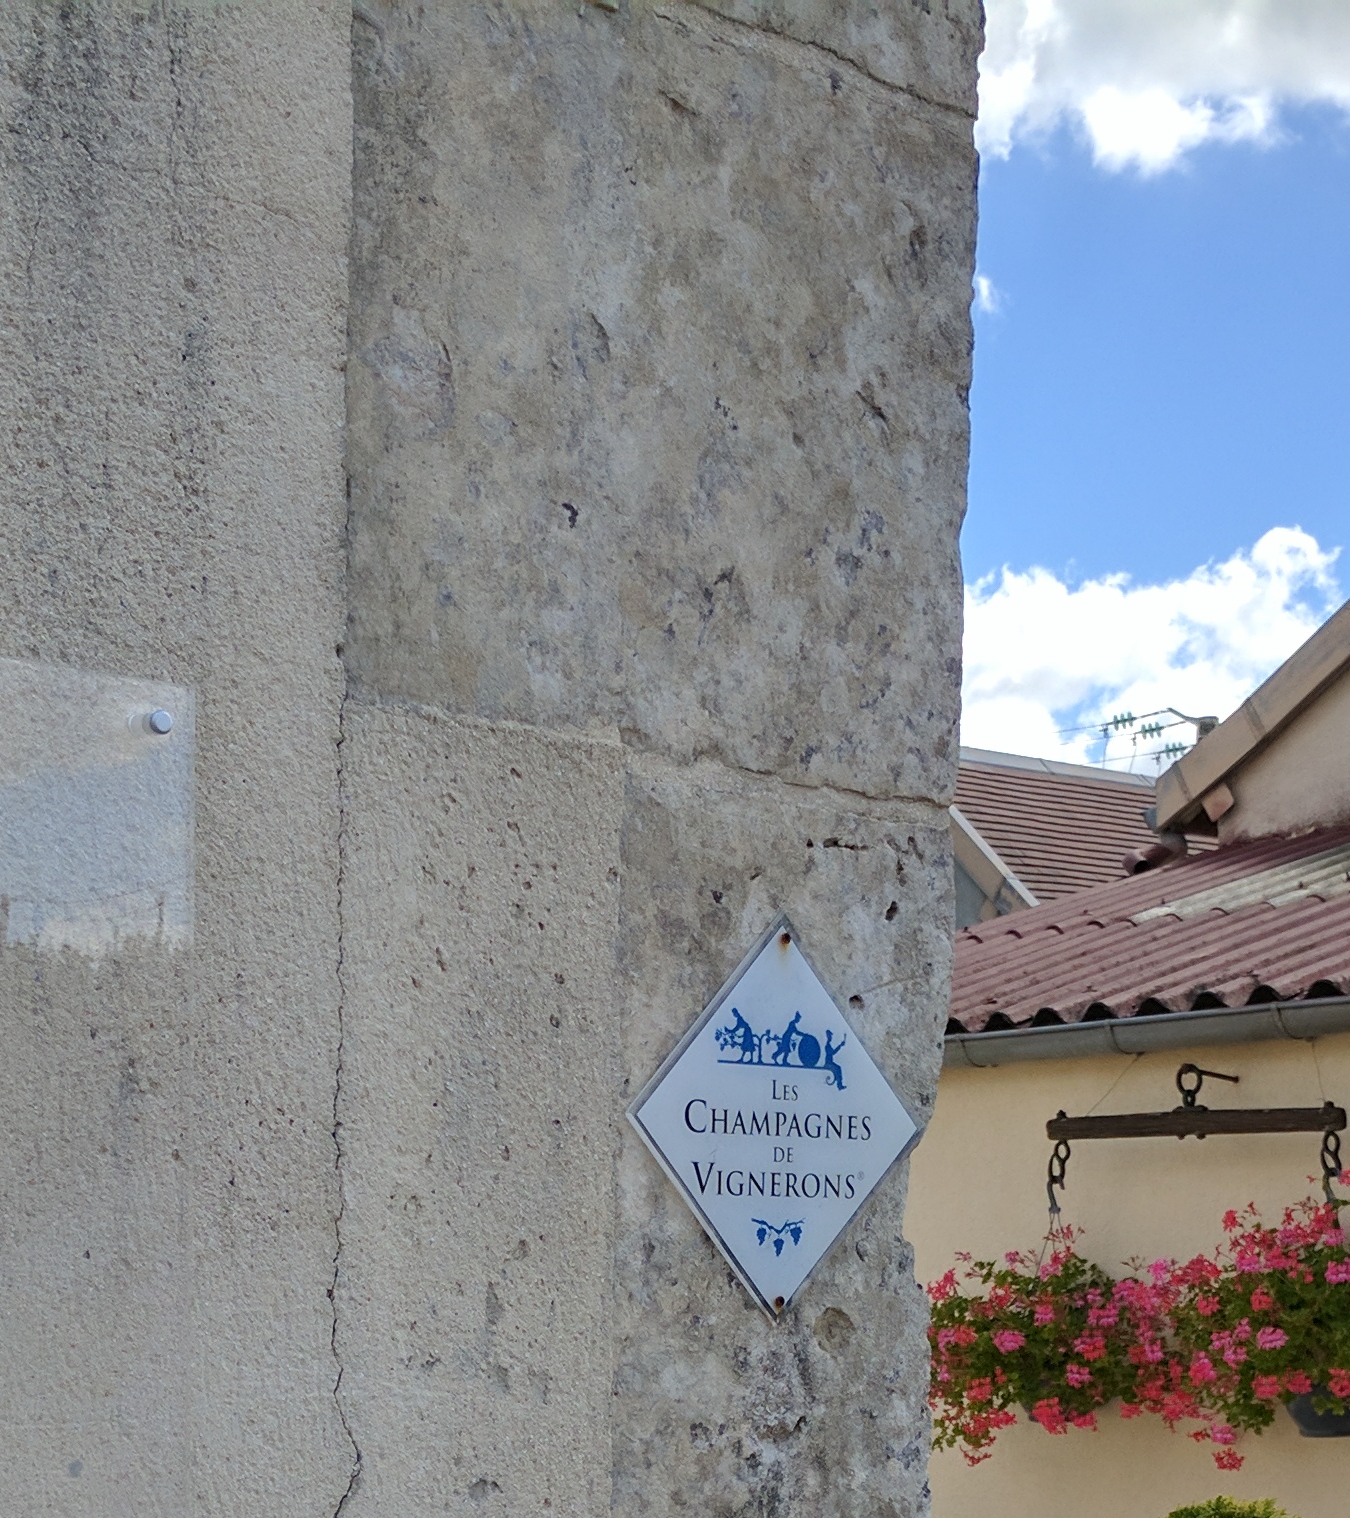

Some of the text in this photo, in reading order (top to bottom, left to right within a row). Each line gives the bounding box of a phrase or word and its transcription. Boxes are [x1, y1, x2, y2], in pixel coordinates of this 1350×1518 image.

[771, 1079, 799, 1102] LES
[684, 1098, 872, 1141] CHAMPAGNES
[773, 1146, 794, 1163] DE
